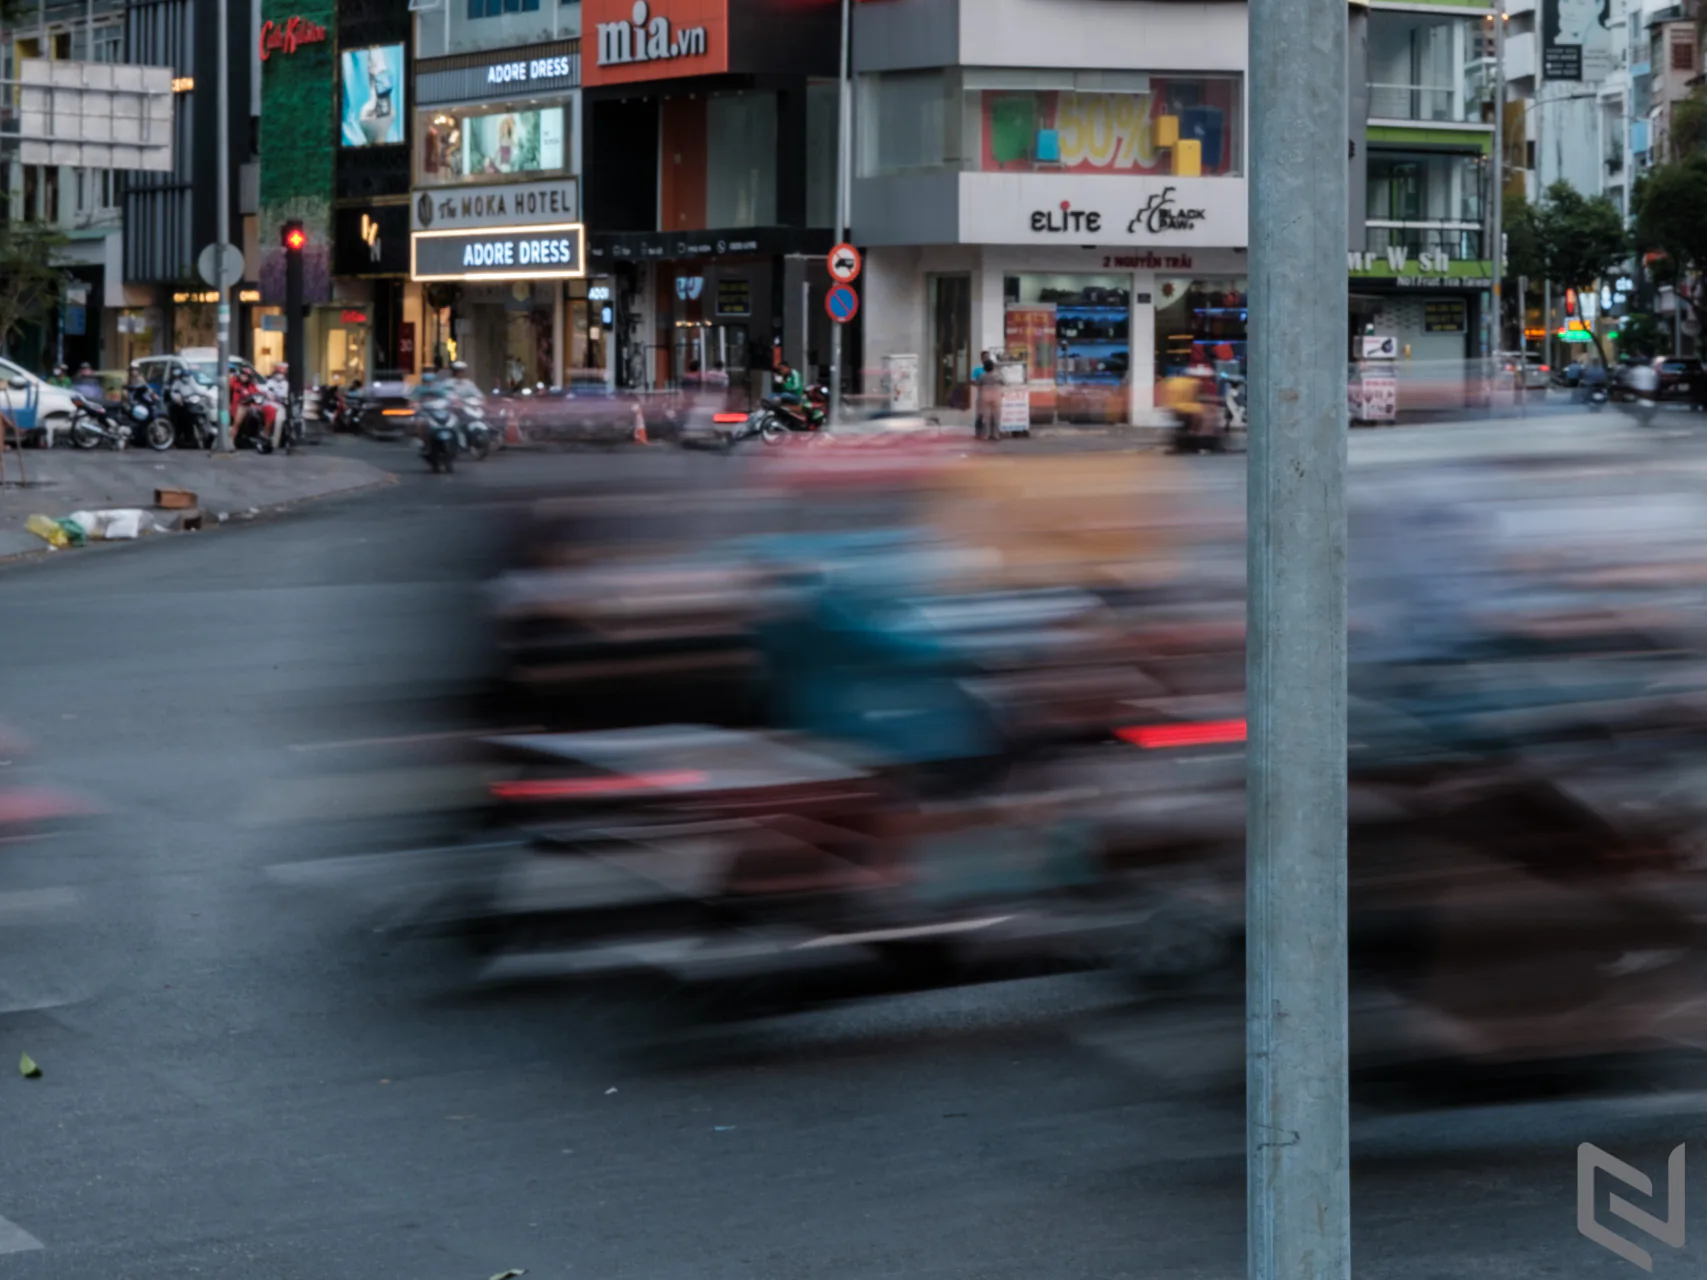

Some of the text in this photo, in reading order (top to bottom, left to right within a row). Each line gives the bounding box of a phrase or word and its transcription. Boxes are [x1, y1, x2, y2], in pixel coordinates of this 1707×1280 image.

[595, 0, 706, 67] mia.vn
[487, 56, 569, 83] ADORE DRESS
[461, 192, 507, 219] MOKA
[515, 189, 571, 215] HOTEL
[463, 241, 514, 266] ADORE
[519, 238, 571, 264] DRESS
[1102, 255, 1111, 268] 2
